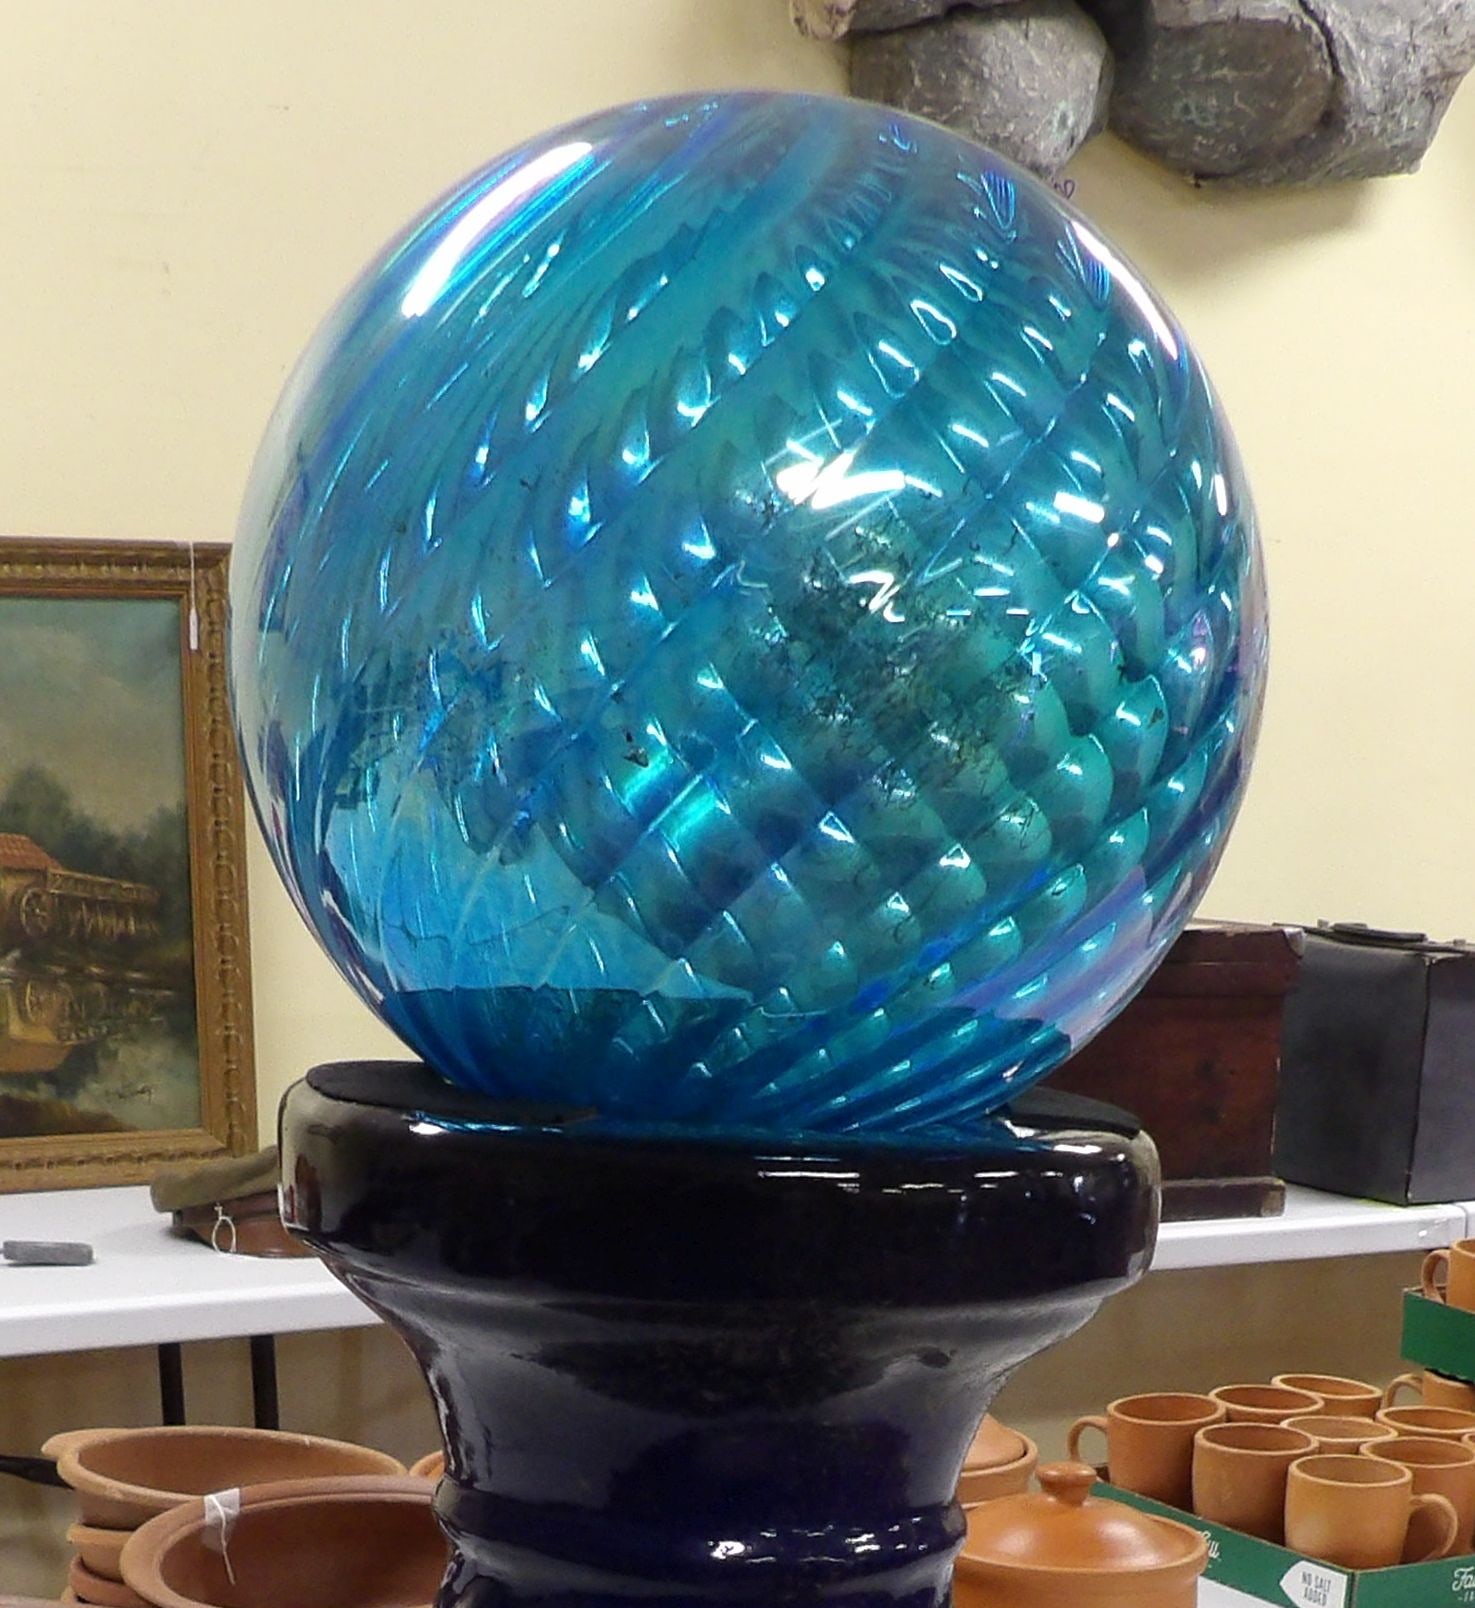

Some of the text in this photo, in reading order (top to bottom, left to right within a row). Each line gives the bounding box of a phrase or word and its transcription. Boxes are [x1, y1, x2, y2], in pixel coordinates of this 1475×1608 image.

[1302, 1571, 1331, 1593] NO SALT
[1303, 1586, 1327, 1607] ADDED
